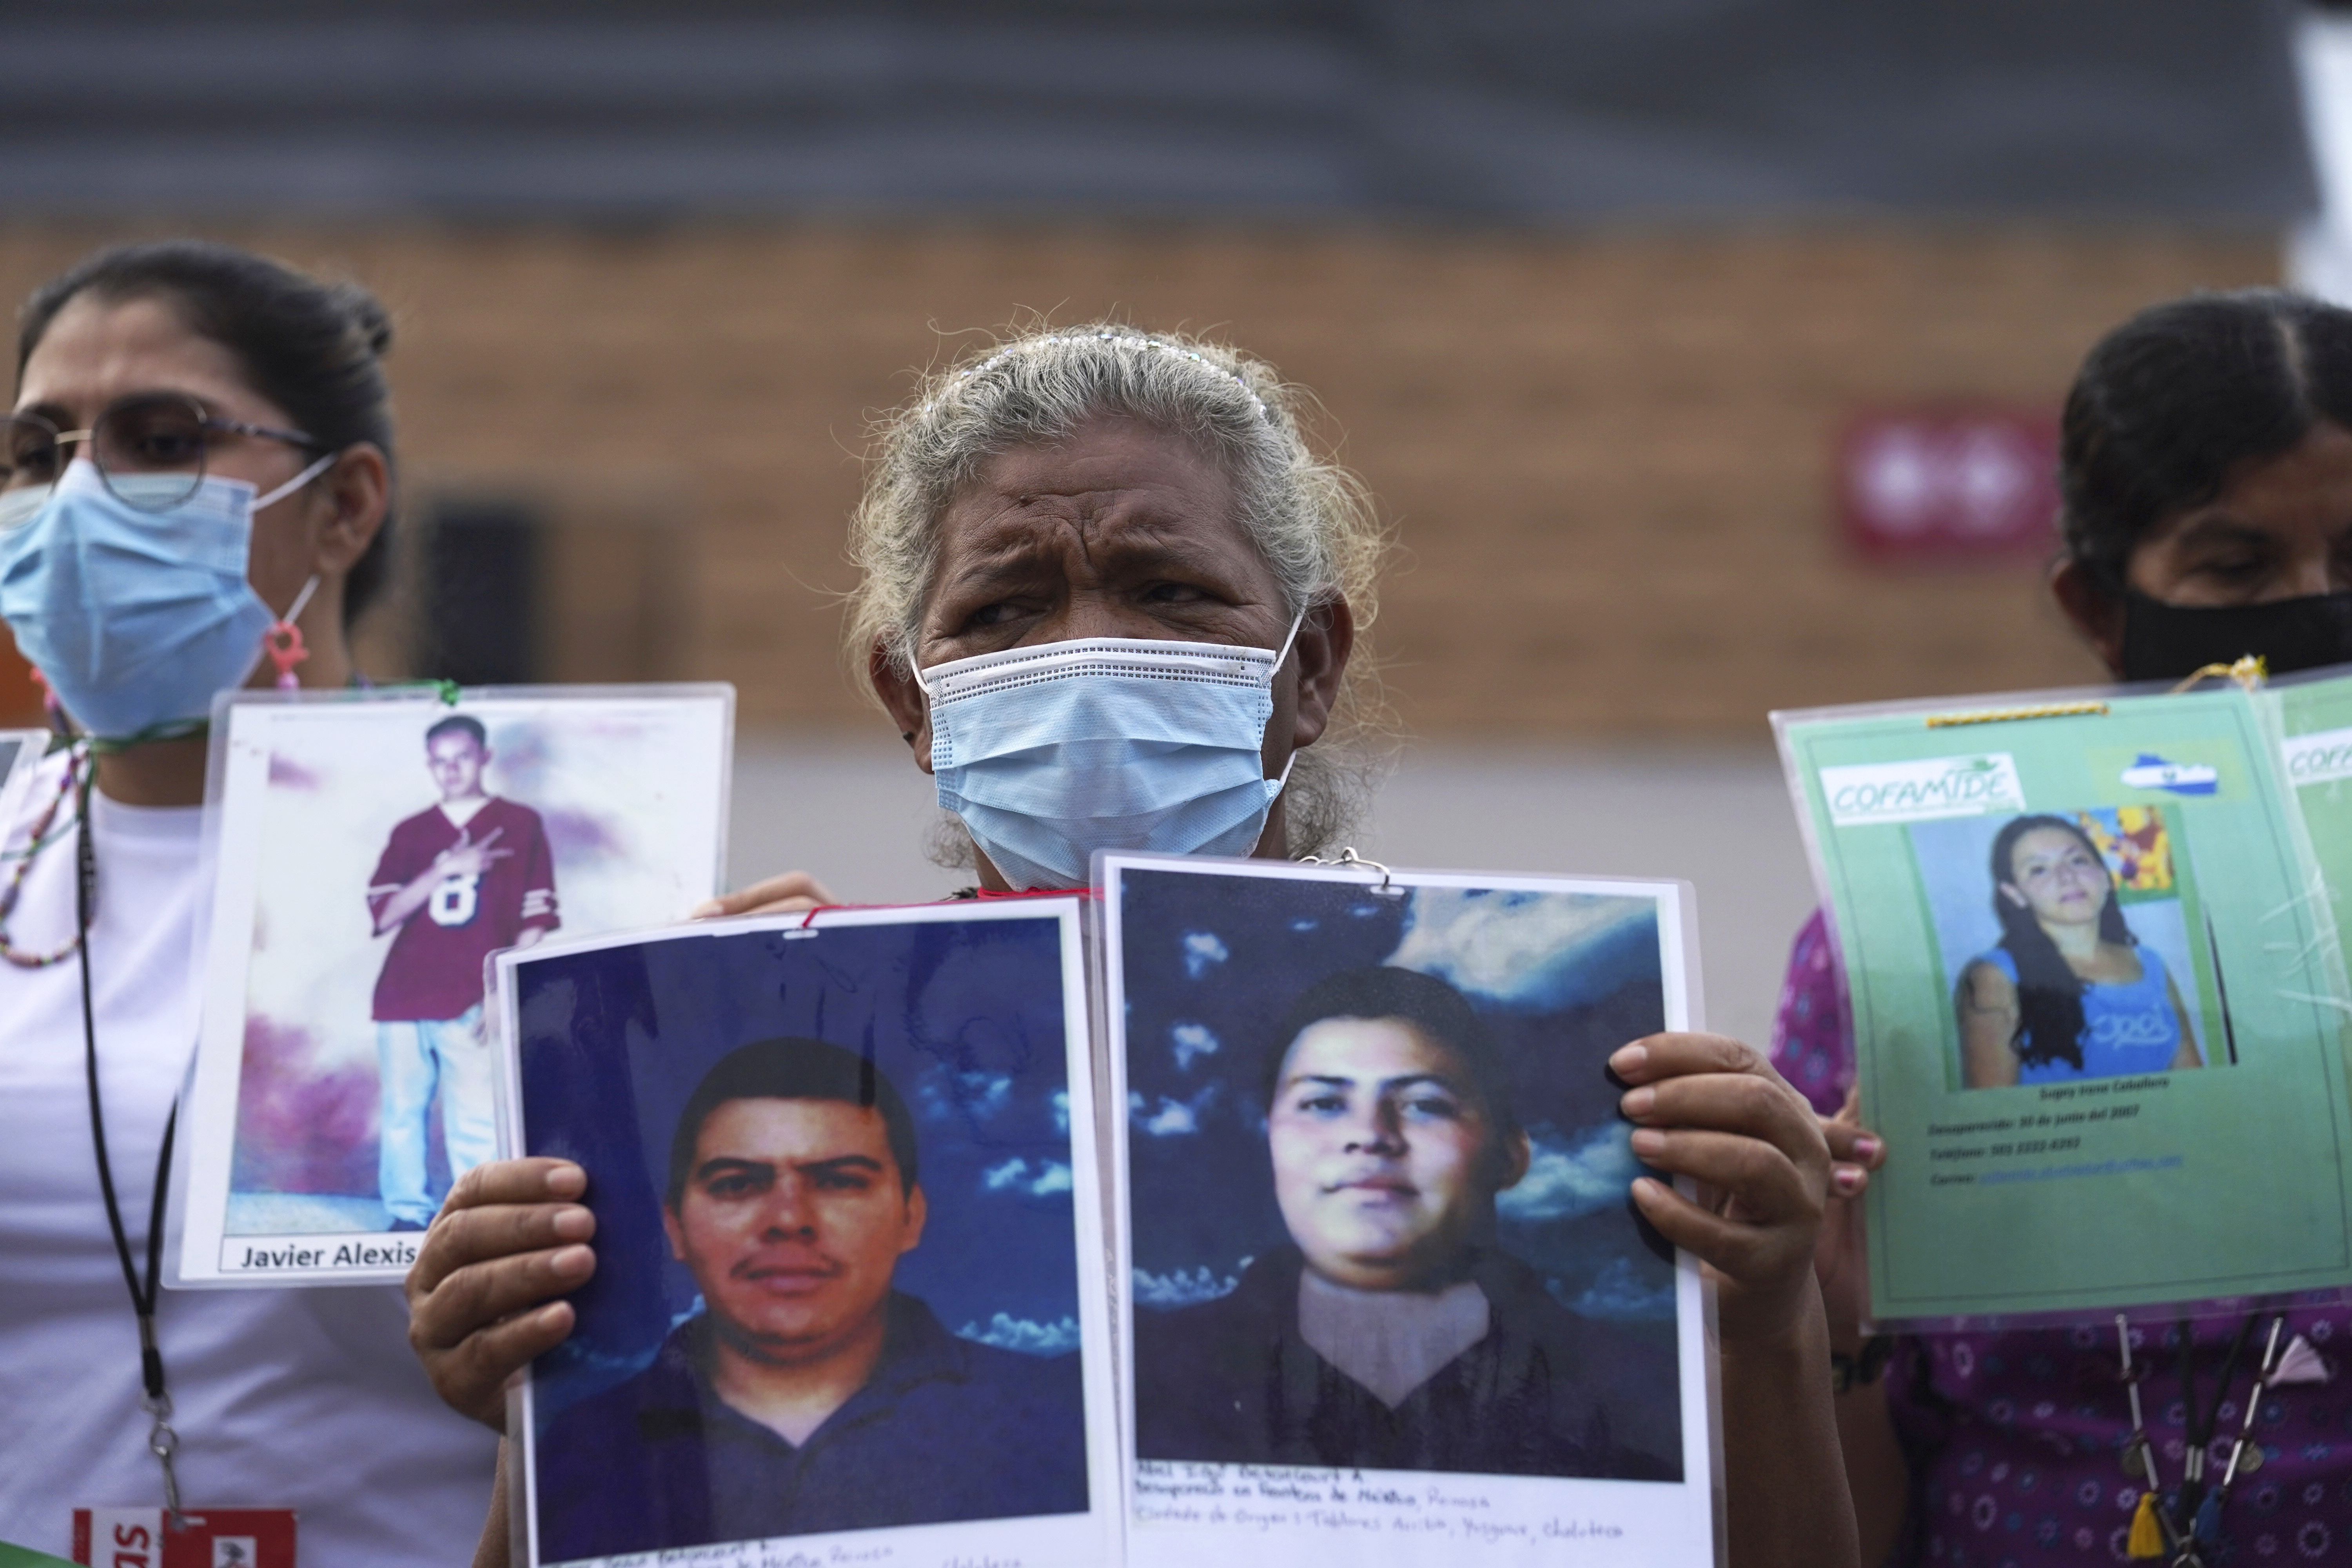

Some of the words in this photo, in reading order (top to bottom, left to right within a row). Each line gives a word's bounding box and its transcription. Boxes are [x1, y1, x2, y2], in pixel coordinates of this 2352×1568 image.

[429, 868, 479, 926] 8
[241, 1243, 325, 1268] Javier
[333, 1240, 416, 1266] Alexis
